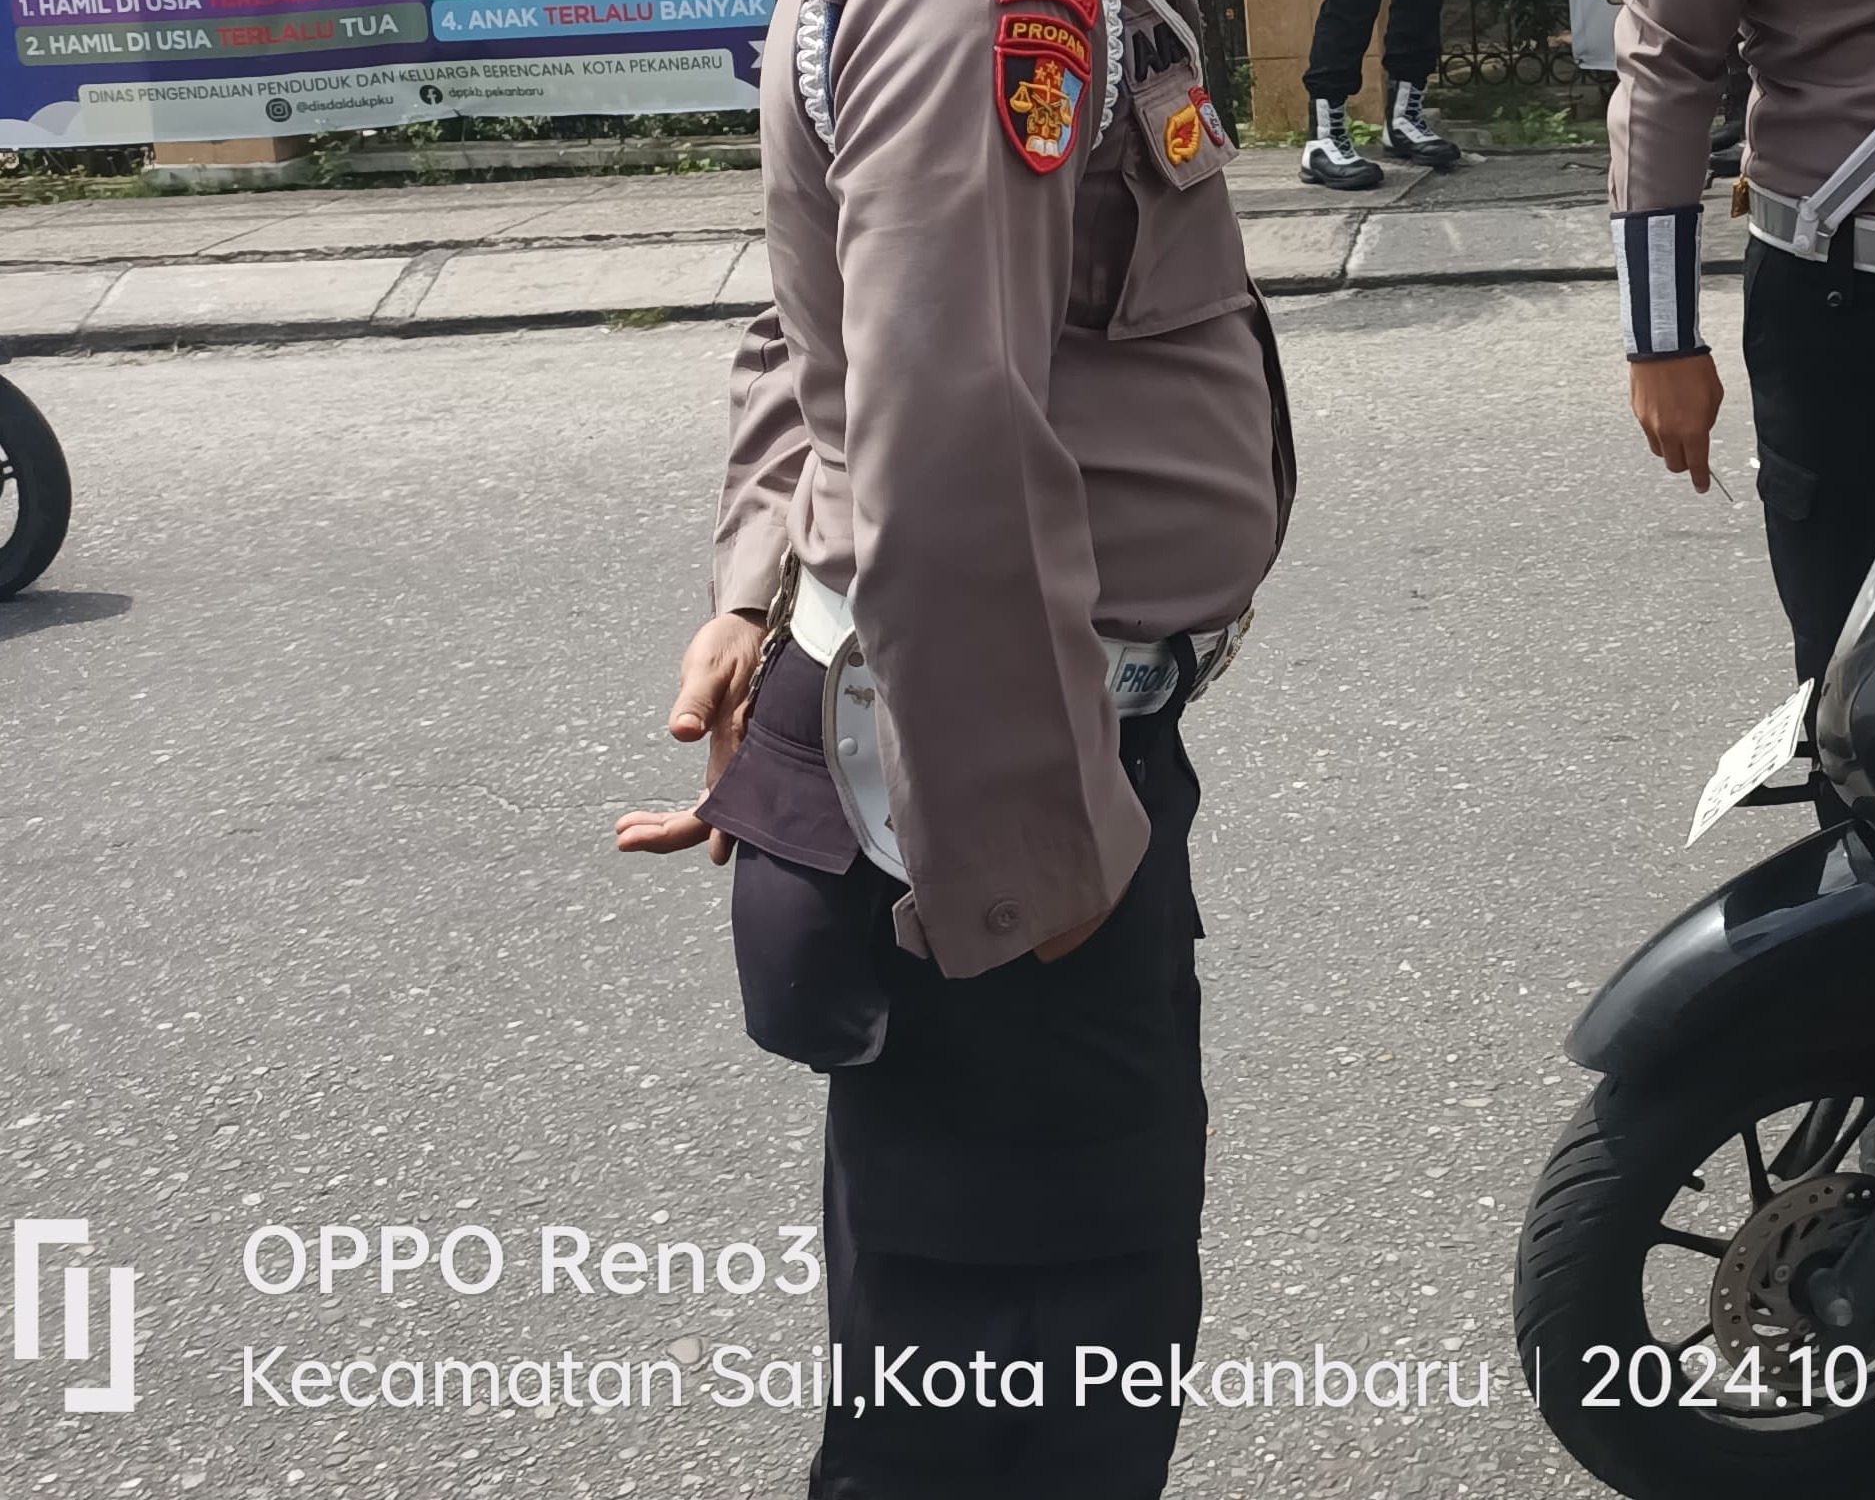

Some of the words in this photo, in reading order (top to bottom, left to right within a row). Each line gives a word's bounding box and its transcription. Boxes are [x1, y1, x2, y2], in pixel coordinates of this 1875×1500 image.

[25, 36, 46, 56] 2.
[50, 33, 123, 55] HAMIL
[127, 32, 151, 51] DI
[157, 28, 213, 51] USIA
[217, 20, 334, 48] TERLALU
[339, 13, 400, 39] TUA
[441, 10, 463, 31] 4.
[469, 5, 539, 30] ANAK
[544, 2, 654, 26] TERLALU
[88, 88, 135, 104] DINAS
[138, 81, 253, 103] PENGENDALIAN
[258, 75, 353, 97] PENDUDUK
[356, 72, 395, 89] DAN
[399, 65, 480, 83] KELUARGA
[483, 60, 575, 78] BERENCANA
[583, 61, 626, 75] KOTA
[630, 55, 723, 73] PEKANBARU
